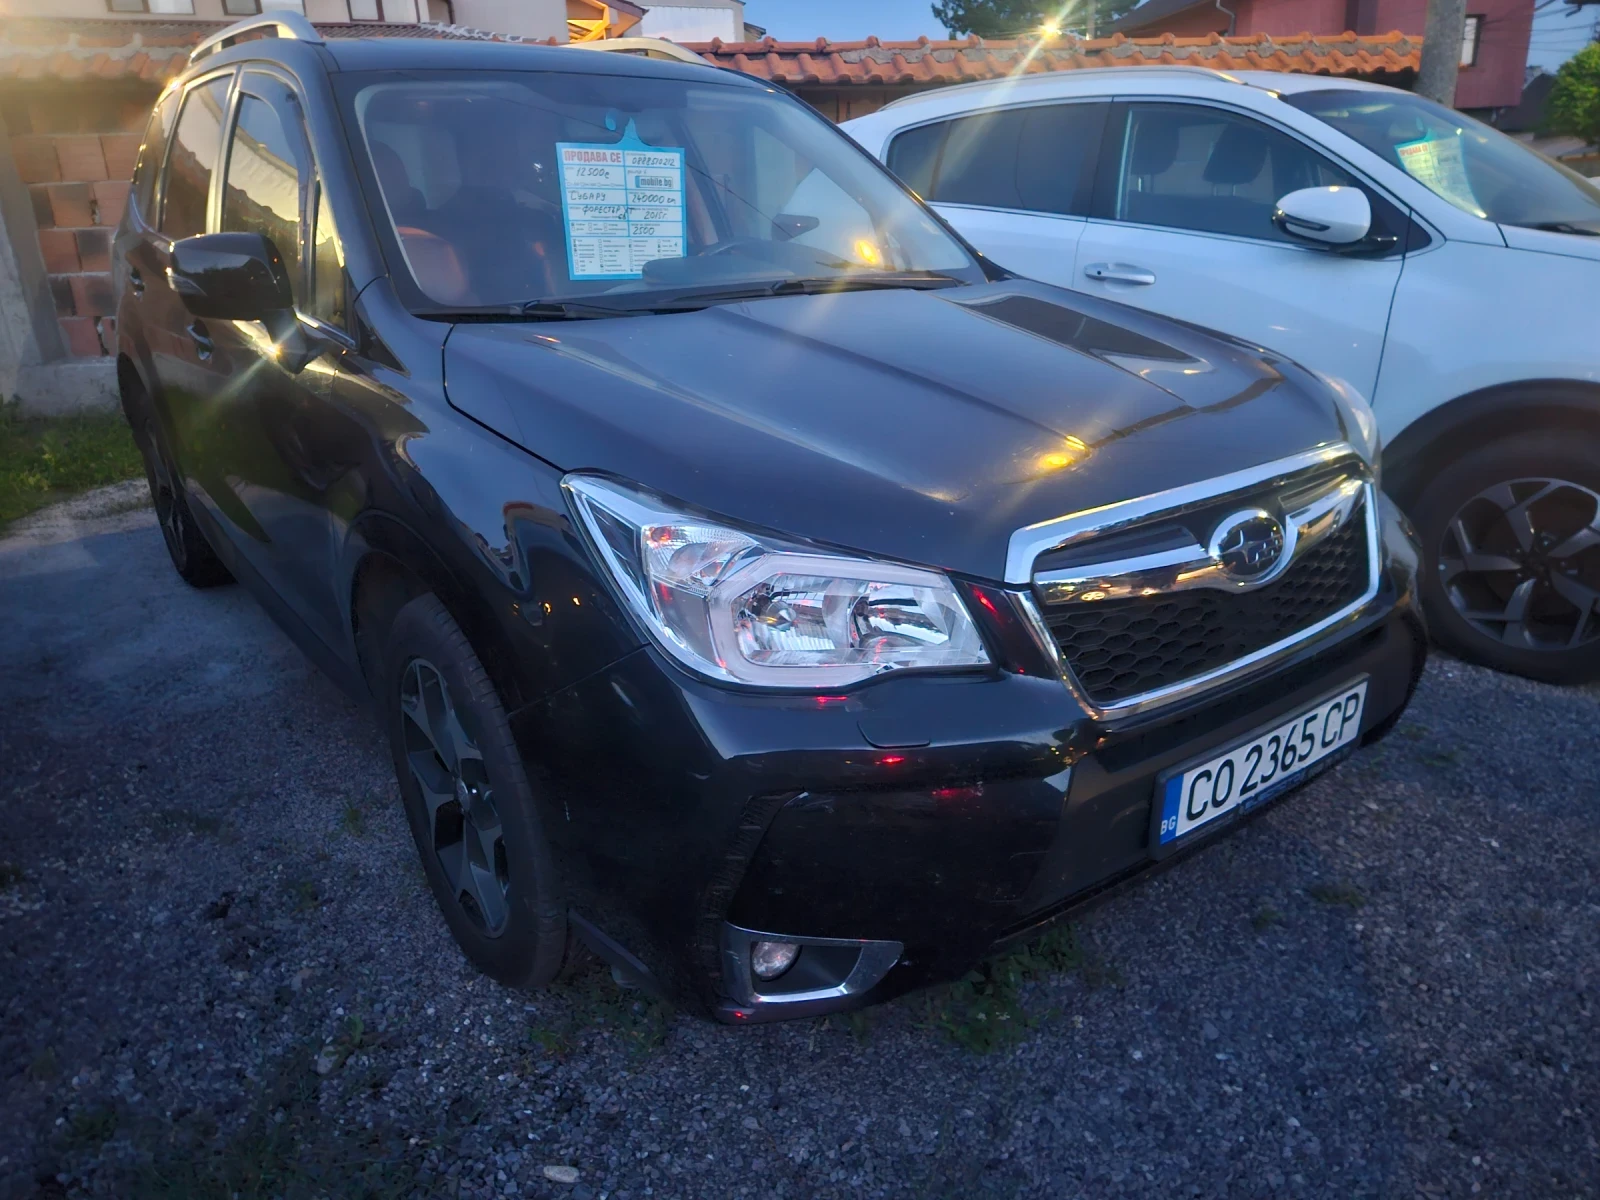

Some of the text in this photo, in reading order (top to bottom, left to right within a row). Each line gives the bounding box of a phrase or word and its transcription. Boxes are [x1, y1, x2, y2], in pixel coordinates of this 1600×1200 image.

[564, 150, 608, 163] ПРОДАВА
[610, 152, 622, 163] СЕ
[640, 177, 672, 188] mobile.bg
[632, 226, 655, 236] 2500
[1186, 758, 1235, 821] CO
[1239, 713, 1319, 798] 2365
[1320, 692, 1361, 750] CP
[1160, 815, 1177, 836] BG
